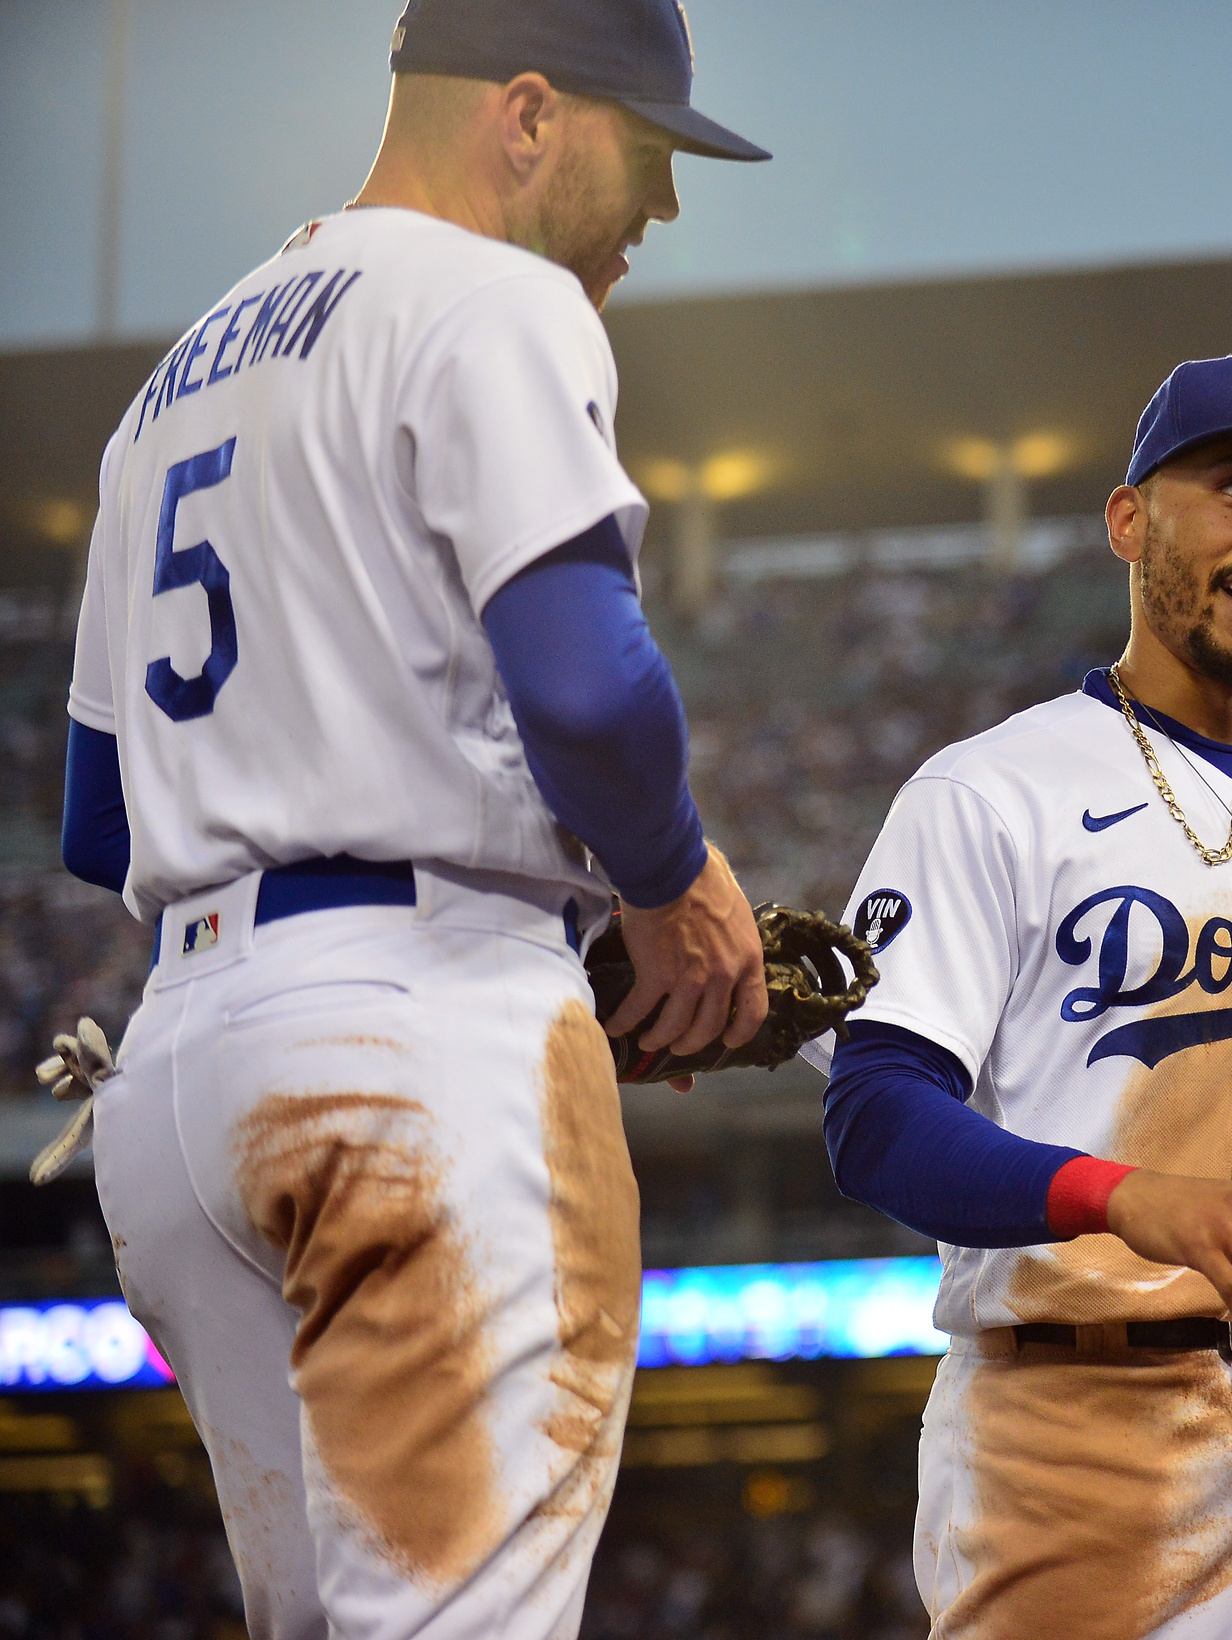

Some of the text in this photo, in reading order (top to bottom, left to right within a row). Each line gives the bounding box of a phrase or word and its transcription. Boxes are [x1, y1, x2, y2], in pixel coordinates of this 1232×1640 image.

[134, 269, 363, 444] FREEMAN
[145, 436, 239, 722] 5
[867, 898, 902, 920] VIN
